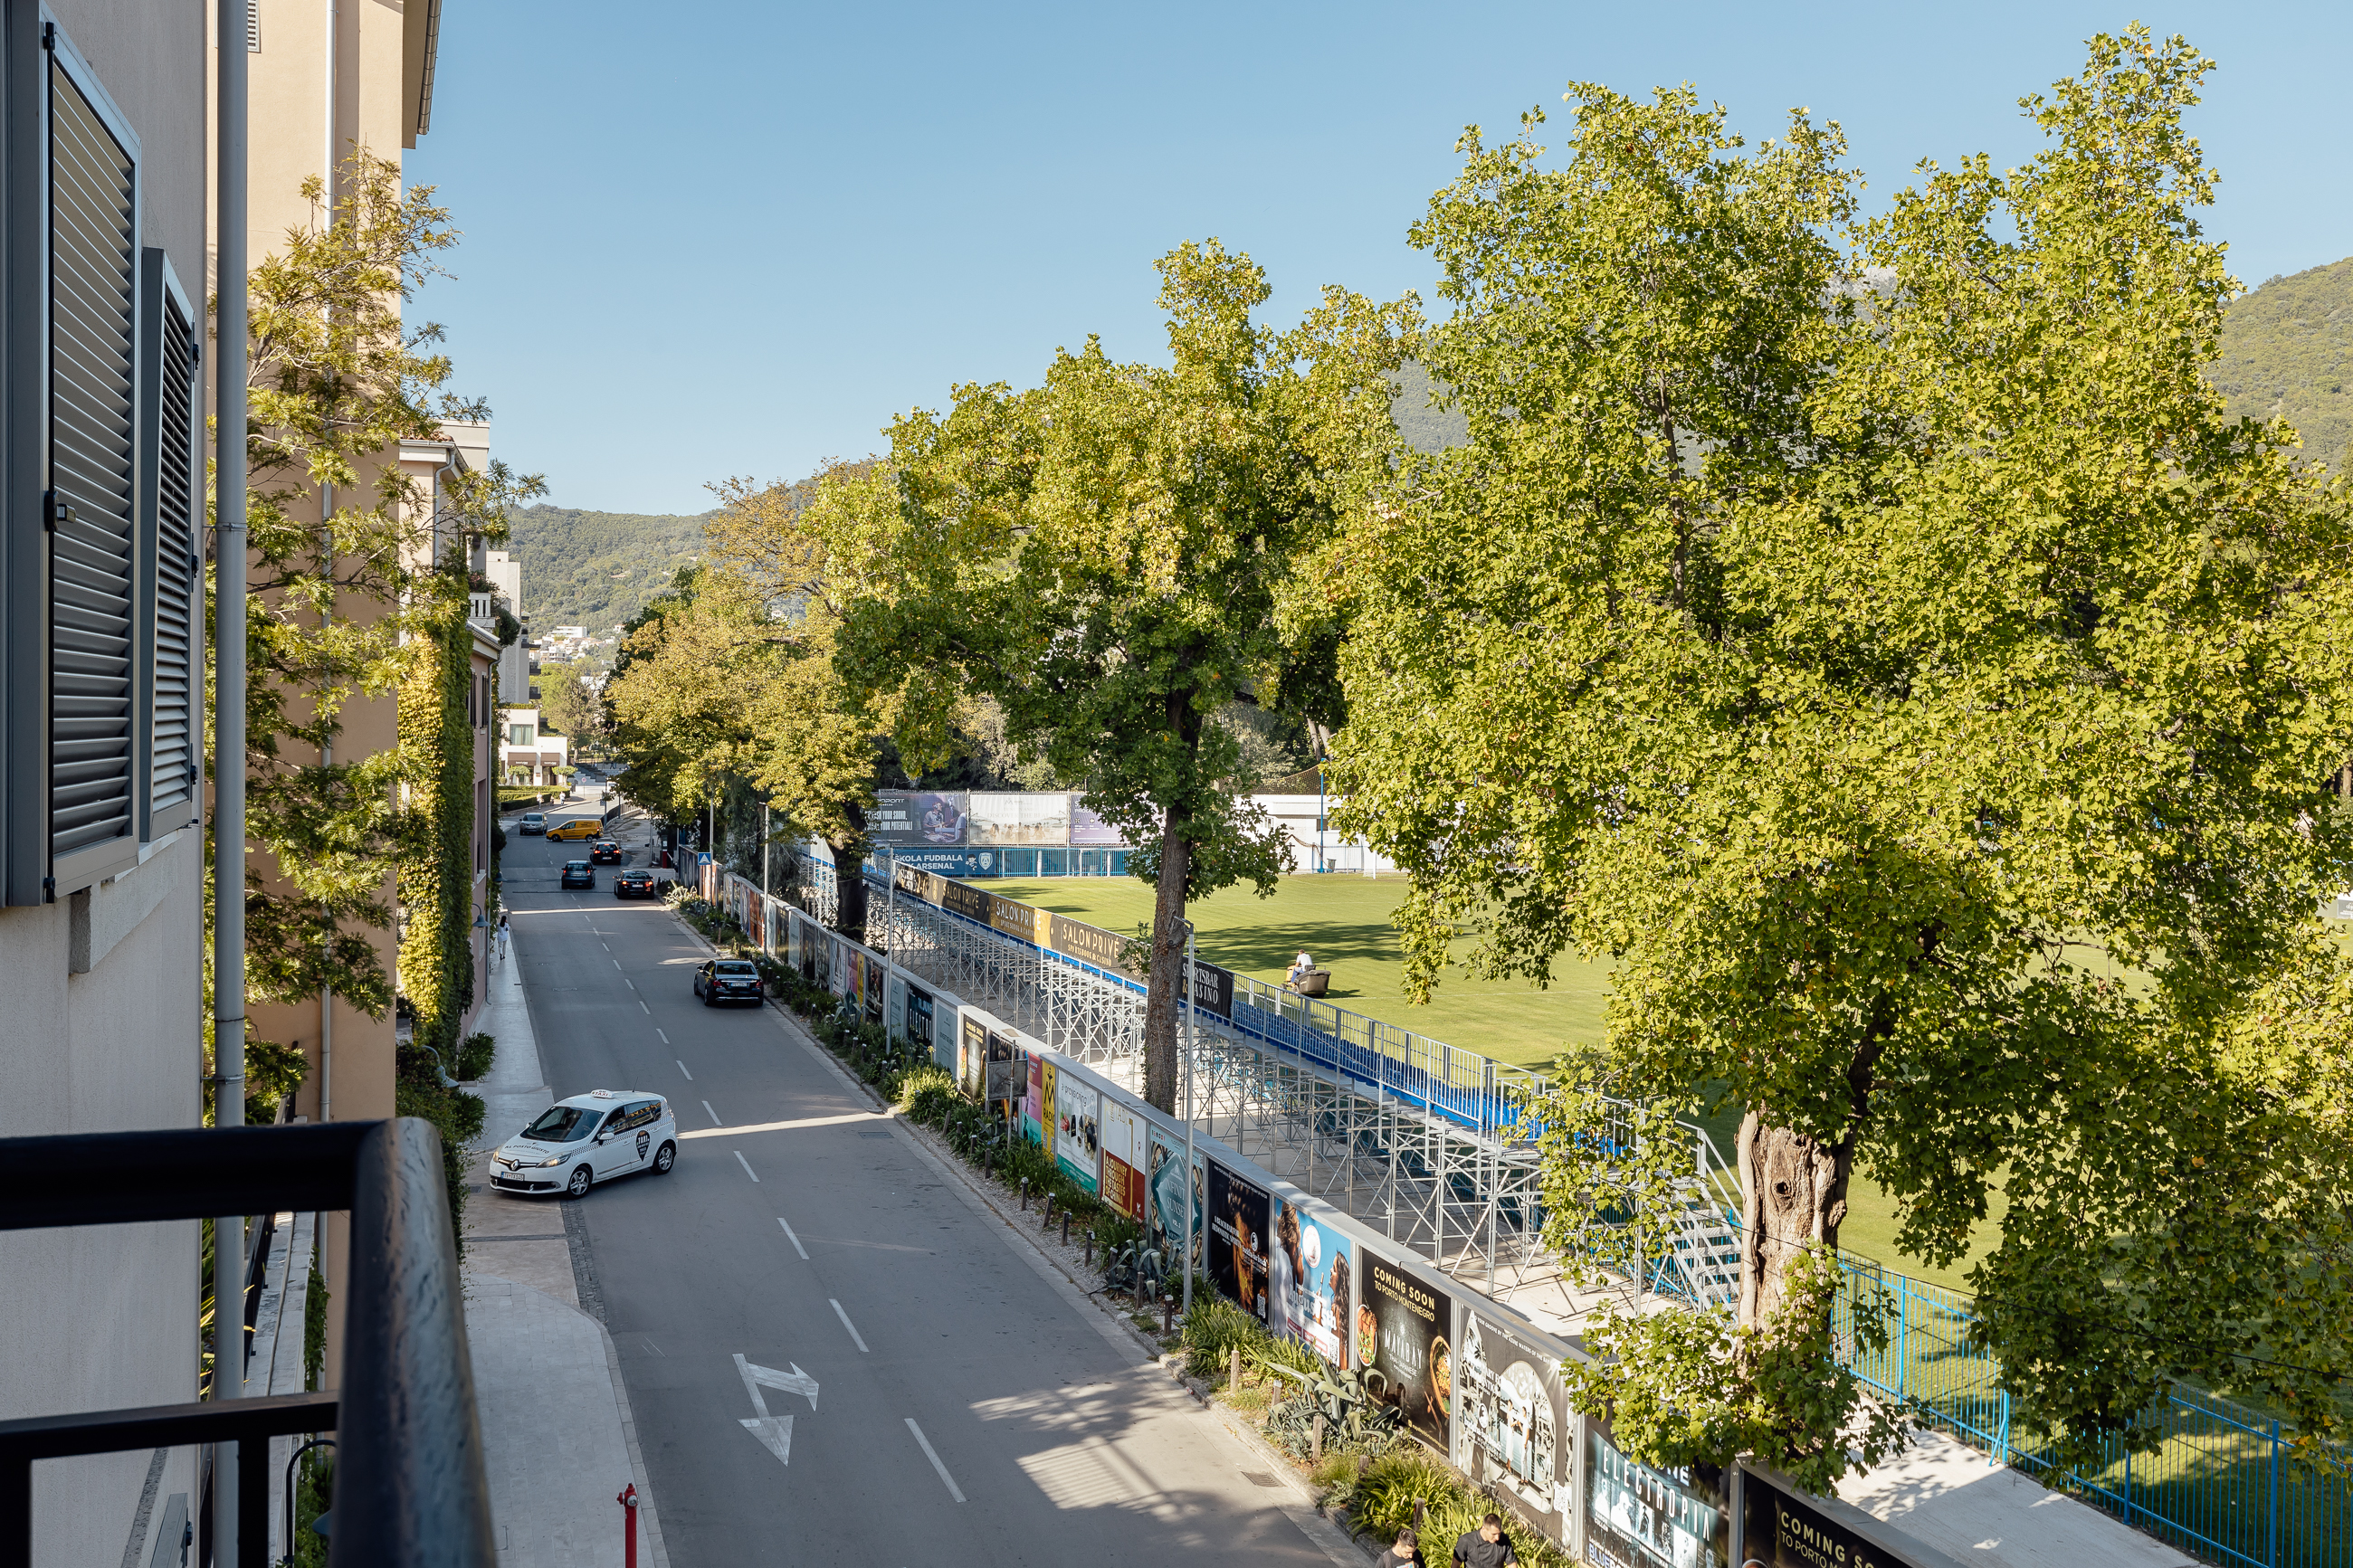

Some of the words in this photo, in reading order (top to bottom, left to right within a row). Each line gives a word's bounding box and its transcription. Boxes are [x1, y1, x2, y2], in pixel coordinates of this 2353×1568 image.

[942, 883, 960, 899] SALON
[996, 901, 1019, 923] SALON
[1062, 923, 1091, 948] SALON
[1092, 933, 1119, 959] PRIVÉ
[1194, 982, 1219, 1004] ASINO
[1110, 1157, 1128, 1177] JOURNEY
[1374, 1266, 1406, 1294] COMING
[1408, 1286, 1435, 1310] SOON
[1375, 1279, 1382, 1291] TO
[1382, 1284, 1399, 1301] PORTO
[1398, 1296, 1435, 1322] MONTENEGRO
[1385, 1328, 1423, 1369] MAYABAY
[1485, 1320, 1498, 1335] GROOVE
[1519, 1340, 1531, 1354] WATERS
[1781, 1511, 1845, 1563] COMING
[1781, 1530, 1793, 1548] TO
[1796, 1540, 1827, 1568] PORTO
